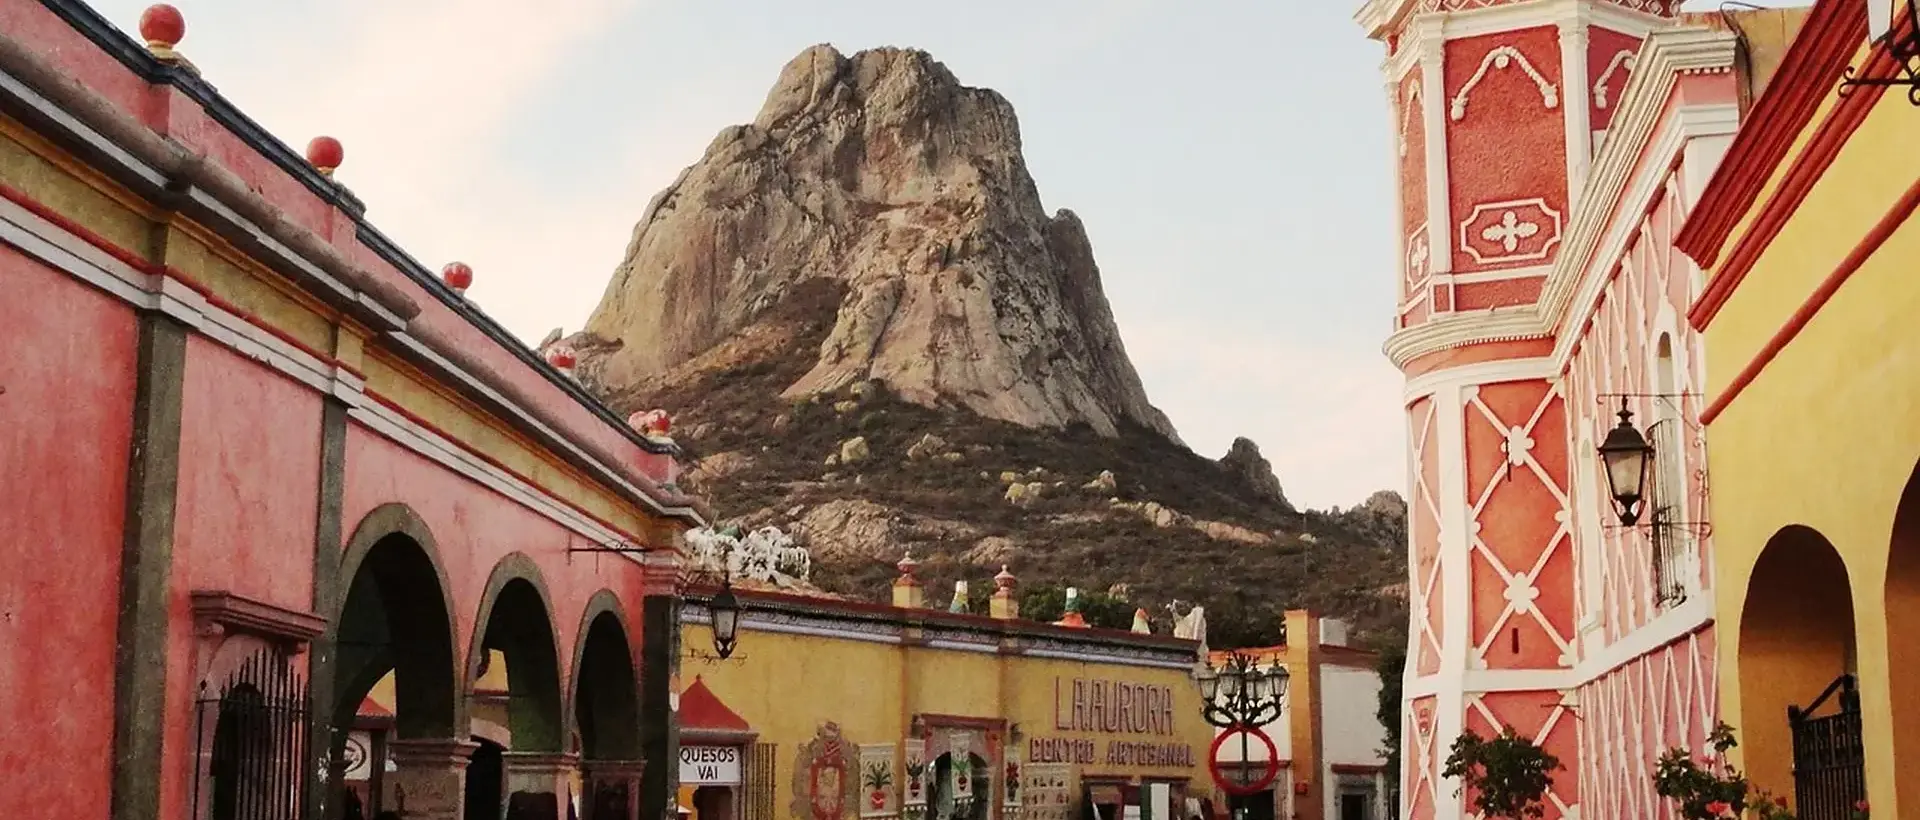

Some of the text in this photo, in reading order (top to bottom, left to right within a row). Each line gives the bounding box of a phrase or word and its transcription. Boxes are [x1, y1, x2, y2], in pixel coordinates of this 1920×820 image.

[1089, 679, 1174, 736] AURORA
[680, 747, 735, 765] QUESOS
[1030, 737, 1196, 768] CENTRO ARTESANAL
